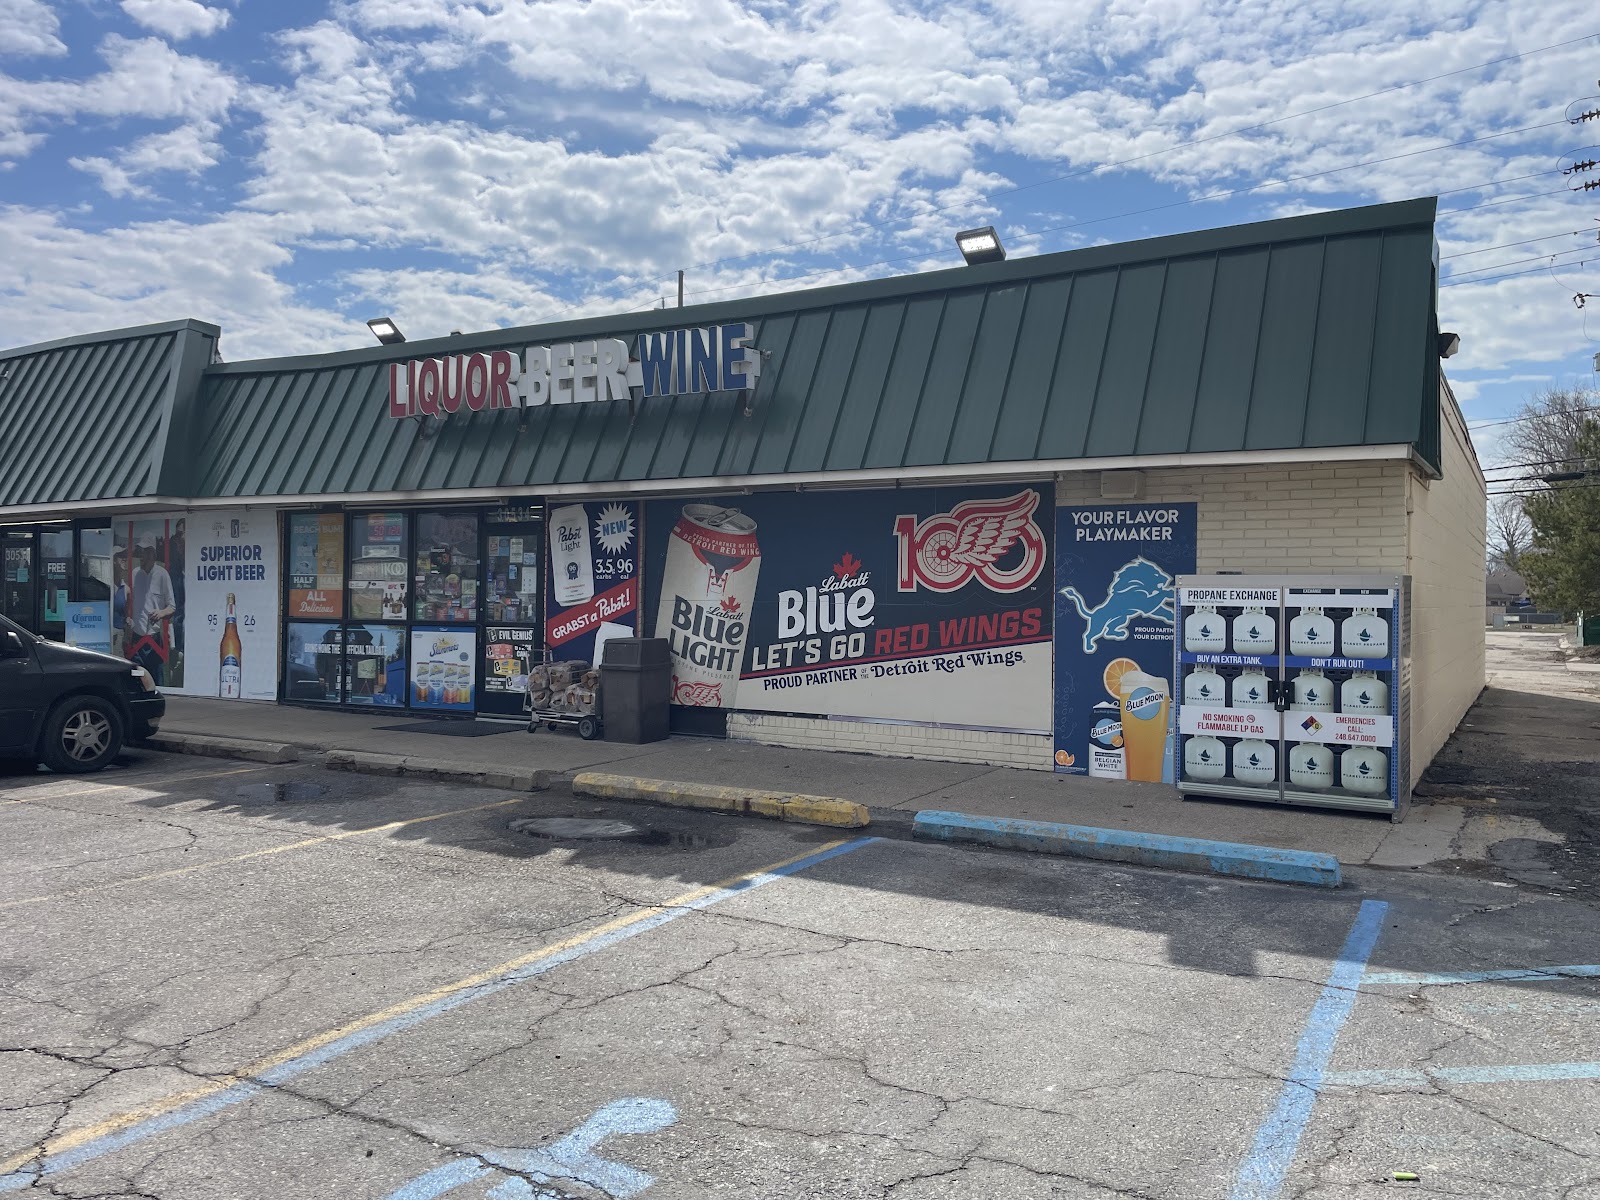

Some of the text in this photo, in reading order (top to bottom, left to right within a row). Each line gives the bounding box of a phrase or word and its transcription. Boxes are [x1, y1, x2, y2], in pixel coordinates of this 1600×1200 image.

[389, 323, 747, 419] LIQUOR BEER WINE
[1071, 510, 1179, 525] YOUR FLAVOR
[557, 526, 582, 543] Pabst
[602, 520, 627, 537] NEW
[1076, 527, 1173, 541] PLAYMAKER
[561, 541, 580, 552] Light
[683, 534, 760, 556] DETROIT RED WING
[711, 539, 736, 548] PARTNER
[200, 545, 262, 562] SUPERIOR
[47, 563, 66, 573] FREE
[617, 558, 633, 573] 96
[197, 565, 265, 581] LIGHT BEER
[818, 572, 870, 593] Labatt
[306, 591, 326, 601] ALL
[1188, 590, 1277, 601] PROPANE EXCHANGE
[299, 602, 334, 613] Delicious
[552, 613, 589, 639] GRABST
[590, 612, 598, 622] a
[595, 588, 631, 618] Pabst!
[706, 606, 744, 620] Labatt
[778, 586, 875, 639] Blue
[72, 613, 102, 624] Corona
[207, 614, 218, 625] 95
[244, 614, 256, 626] 2.6
[672, 594, 745, 646] Blue
[498, 629, 533, 640] EVIL GENIUS
[752, 607, 1042, 671] LET'S GO RED WINGS
[331, 643, 341, 654] THE
[669, 628, 740, 672] LIGHT
[1197, 655, 1262, 665] BUY AN EXTRA TANK.
[1311, 658, 1364, 668] DON'T RUN OUT!
[702, 671, 734, 680] PILSENER
[764, 675, 802, 691] PROUD
[806, 668, 858, 686] PARTNER
[870, 659, 930, 678] Detroit
[931, 655, 965, 673] Red
[966, 650, 1023, 667] Wings
[1125, 693, 1164, 711] BLUE MOON
[1203, 713, 1244, 723] NO SMOKING
[1335, 716, 1376, 725] EMERGENCIES
[1092, 723, 1122, 737] BLUE MOON
[1197, 722, 1239, 732] FLAMMABLE
[1250, 725, 1264, 733] GAS
[1347, 725, 1363, 733] CALL:
[1335, 733, 1376, 742] 248.647.0000
